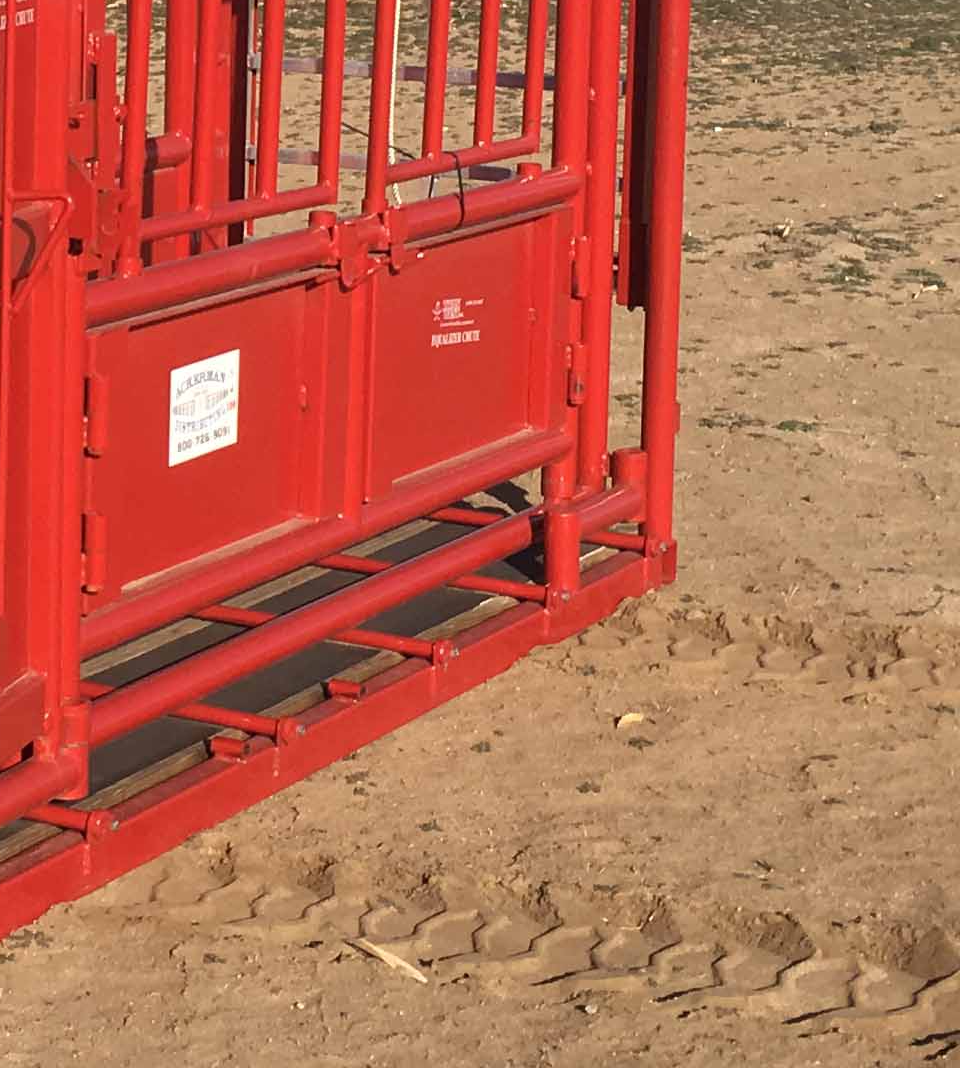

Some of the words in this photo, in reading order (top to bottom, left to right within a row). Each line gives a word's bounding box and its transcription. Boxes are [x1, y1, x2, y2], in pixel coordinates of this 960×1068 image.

[176, 370, 226, 399] ACKERMAN
[177, 439, 192, 453] 800
[196, 433, 210, 445] 726
